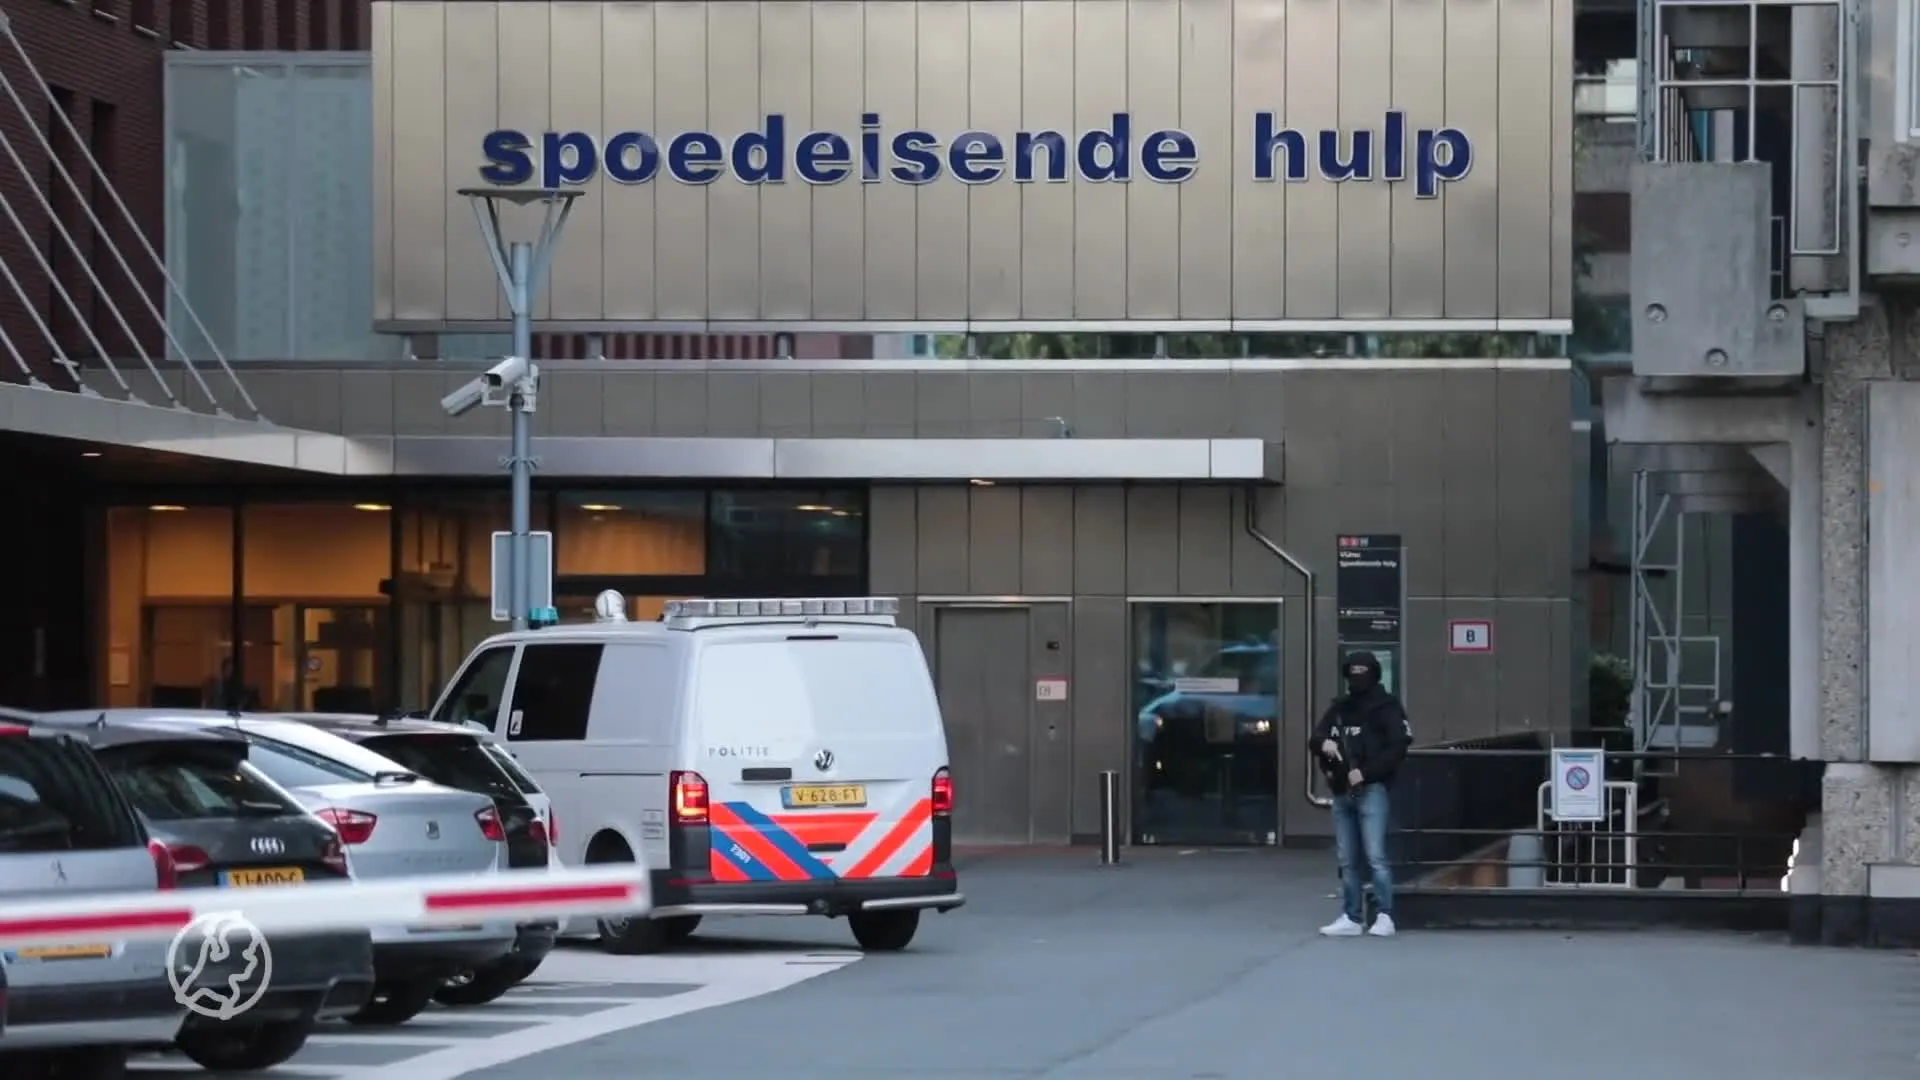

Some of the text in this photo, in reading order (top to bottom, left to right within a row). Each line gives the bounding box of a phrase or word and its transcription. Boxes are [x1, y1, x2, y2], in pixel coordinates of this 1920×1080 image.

[479, 111, 1472, 198] spoedeisende hulp
[1466, 629, 1476, 643] B
[708, 745, 769, 757] POLITIE
